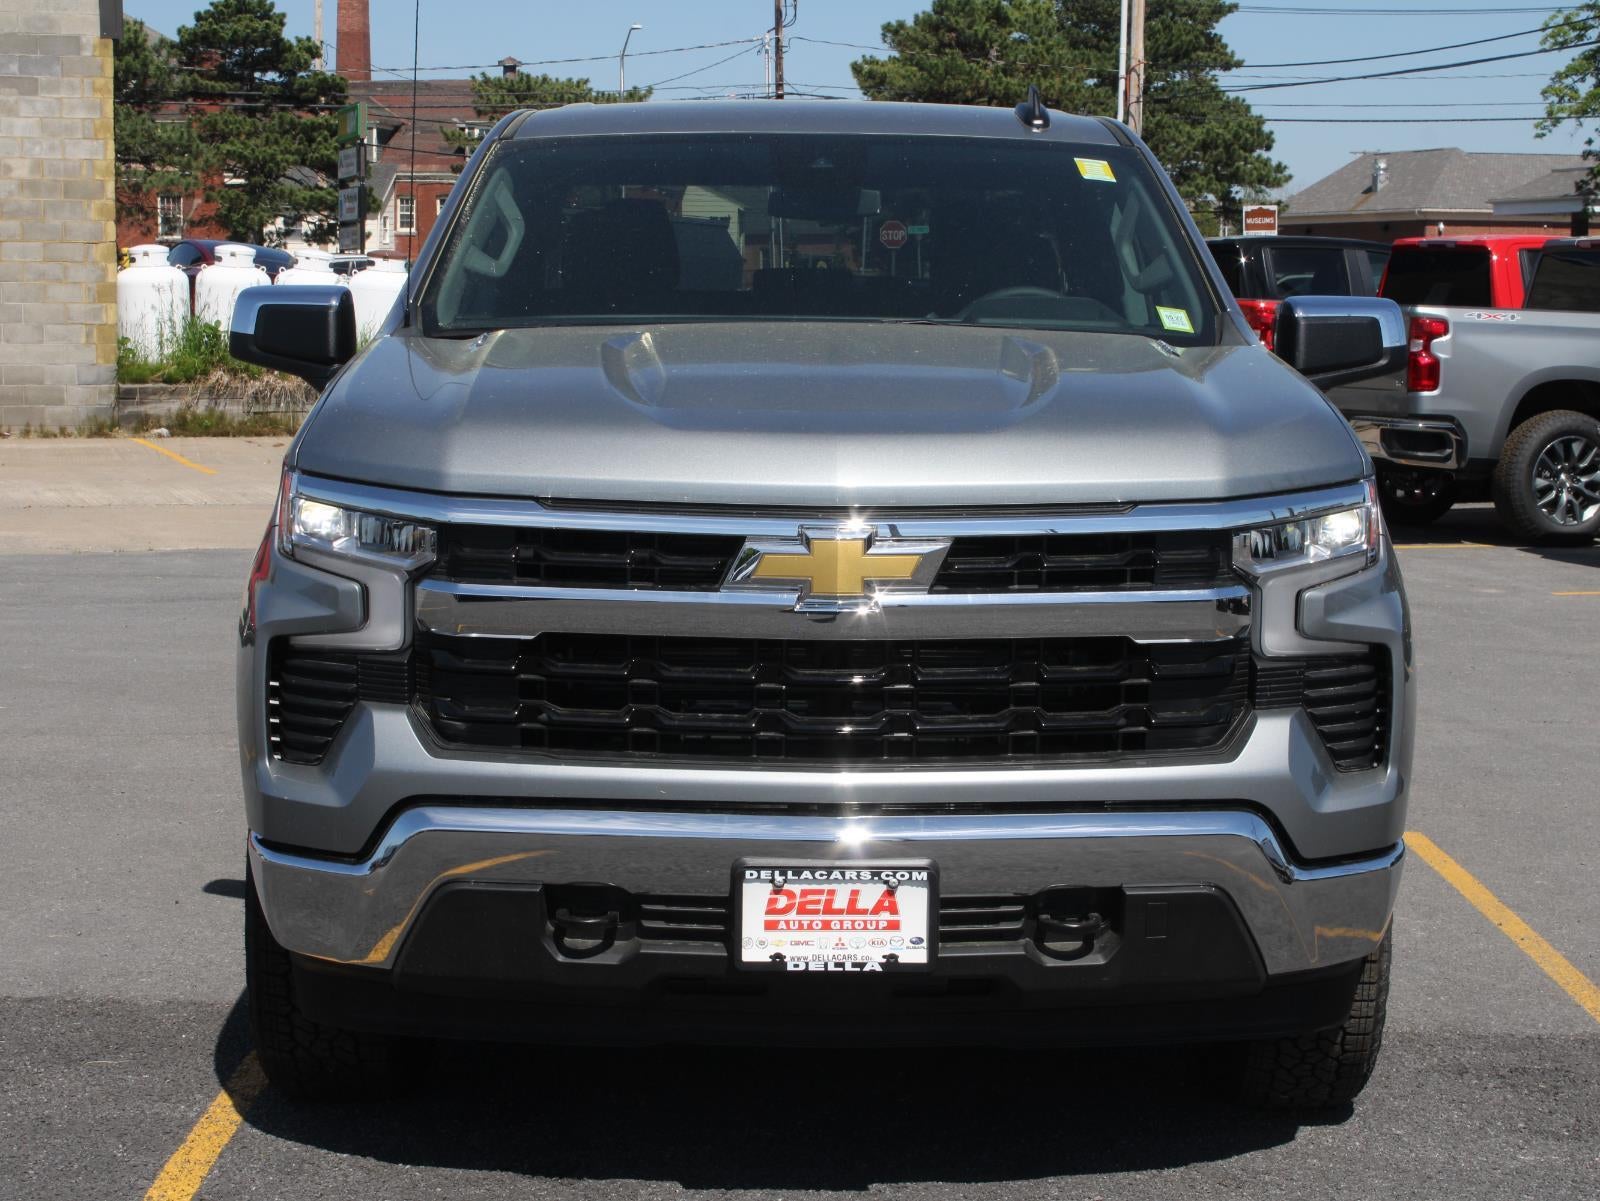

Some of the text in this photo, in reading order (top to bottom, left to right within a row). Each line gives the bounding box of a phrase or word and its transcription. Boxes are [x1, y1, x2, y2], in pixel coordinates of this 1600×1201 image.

[881, 230, 905, 240] STOP
[745, 870, 928, 880] DELLACARS.COM
[764, 888, 900, 915] DELLA
[777, 920, 888, 930] AUTO GROUP
[786, 961, 883, 971] DELLA
